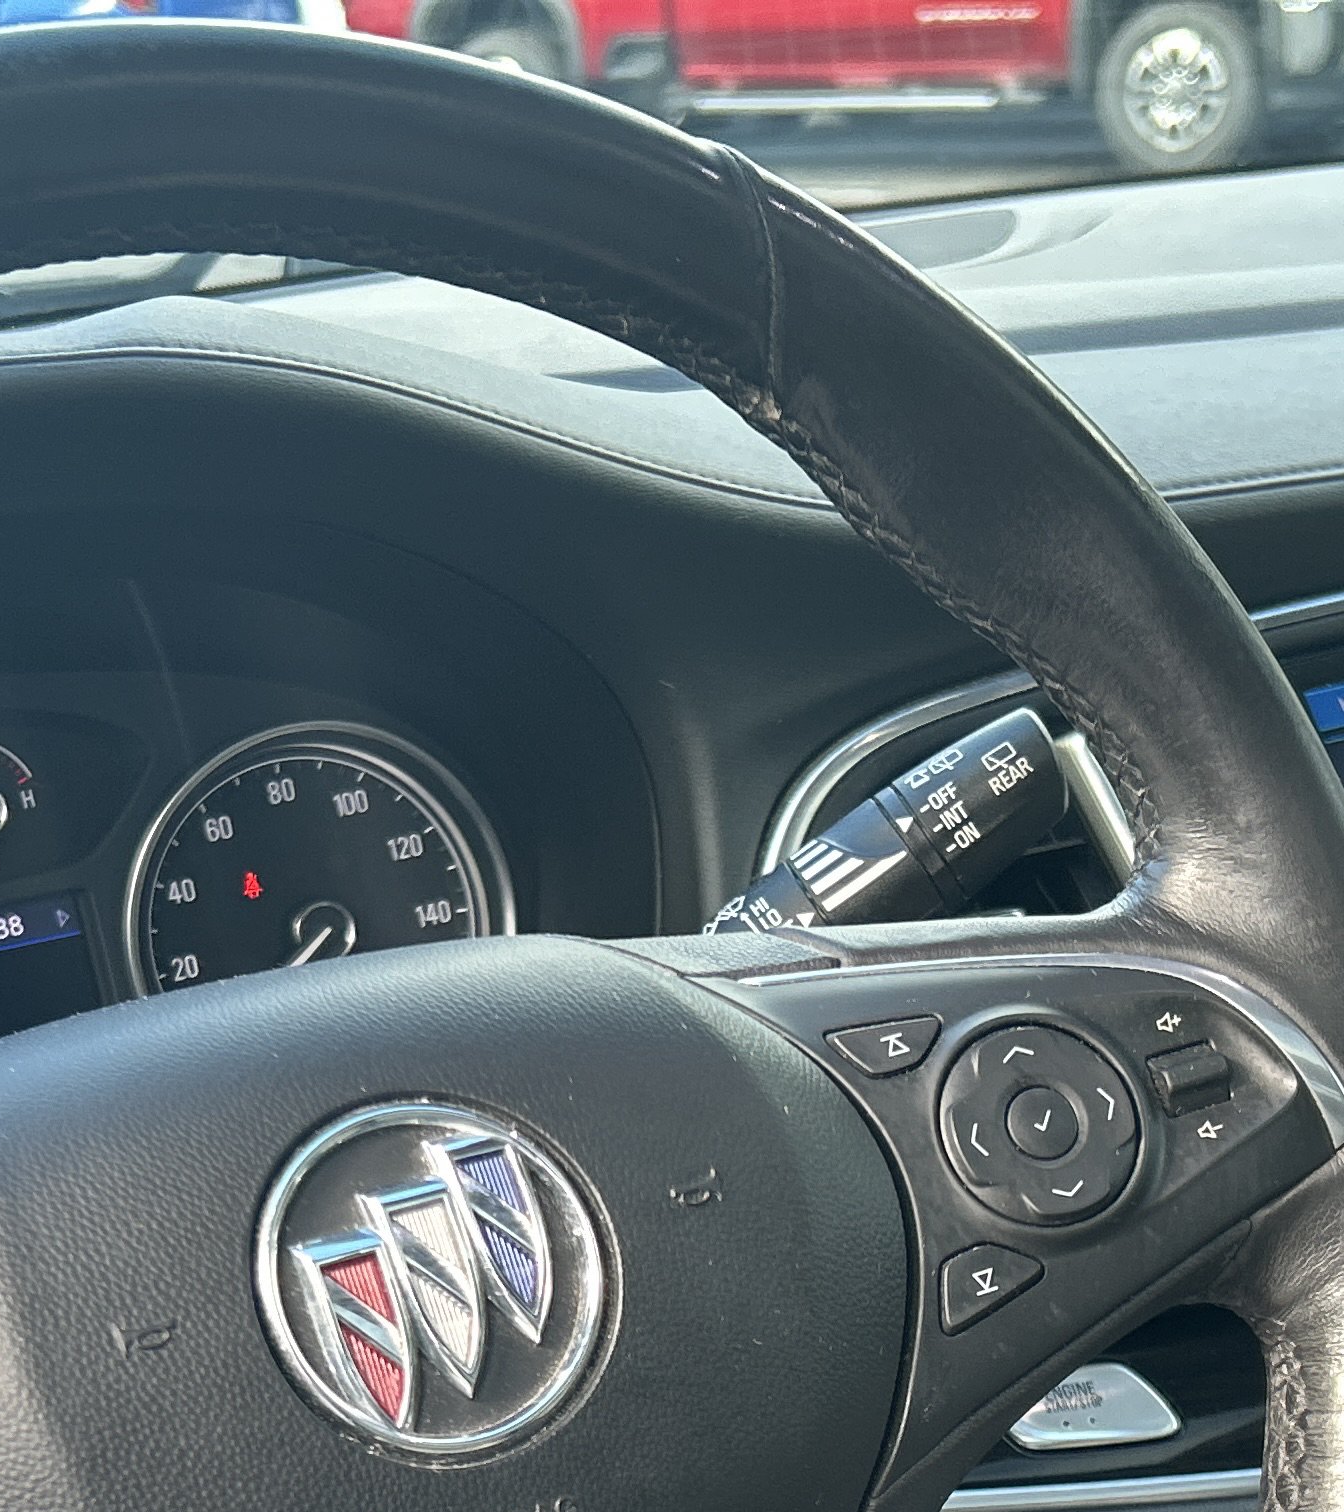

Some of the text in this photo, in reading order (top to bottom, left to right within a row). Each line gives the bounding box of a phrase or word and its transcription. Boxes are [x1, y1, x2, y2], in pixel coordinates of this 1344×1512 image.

[988, 757, 1035, 797] REAR
[19, 790, 37, 810] H
[267, 777, 296, 806] 80
[332, 789, 369, 817] 100
[204, 816, 234, 843] 60
[387, 833, 424, 861] 120
[168, 878, 197, 904] 40
[415, 900, 452, 928] 140
[749, 897, 771, 918] HI
[171, 955, 200, 982] 20
